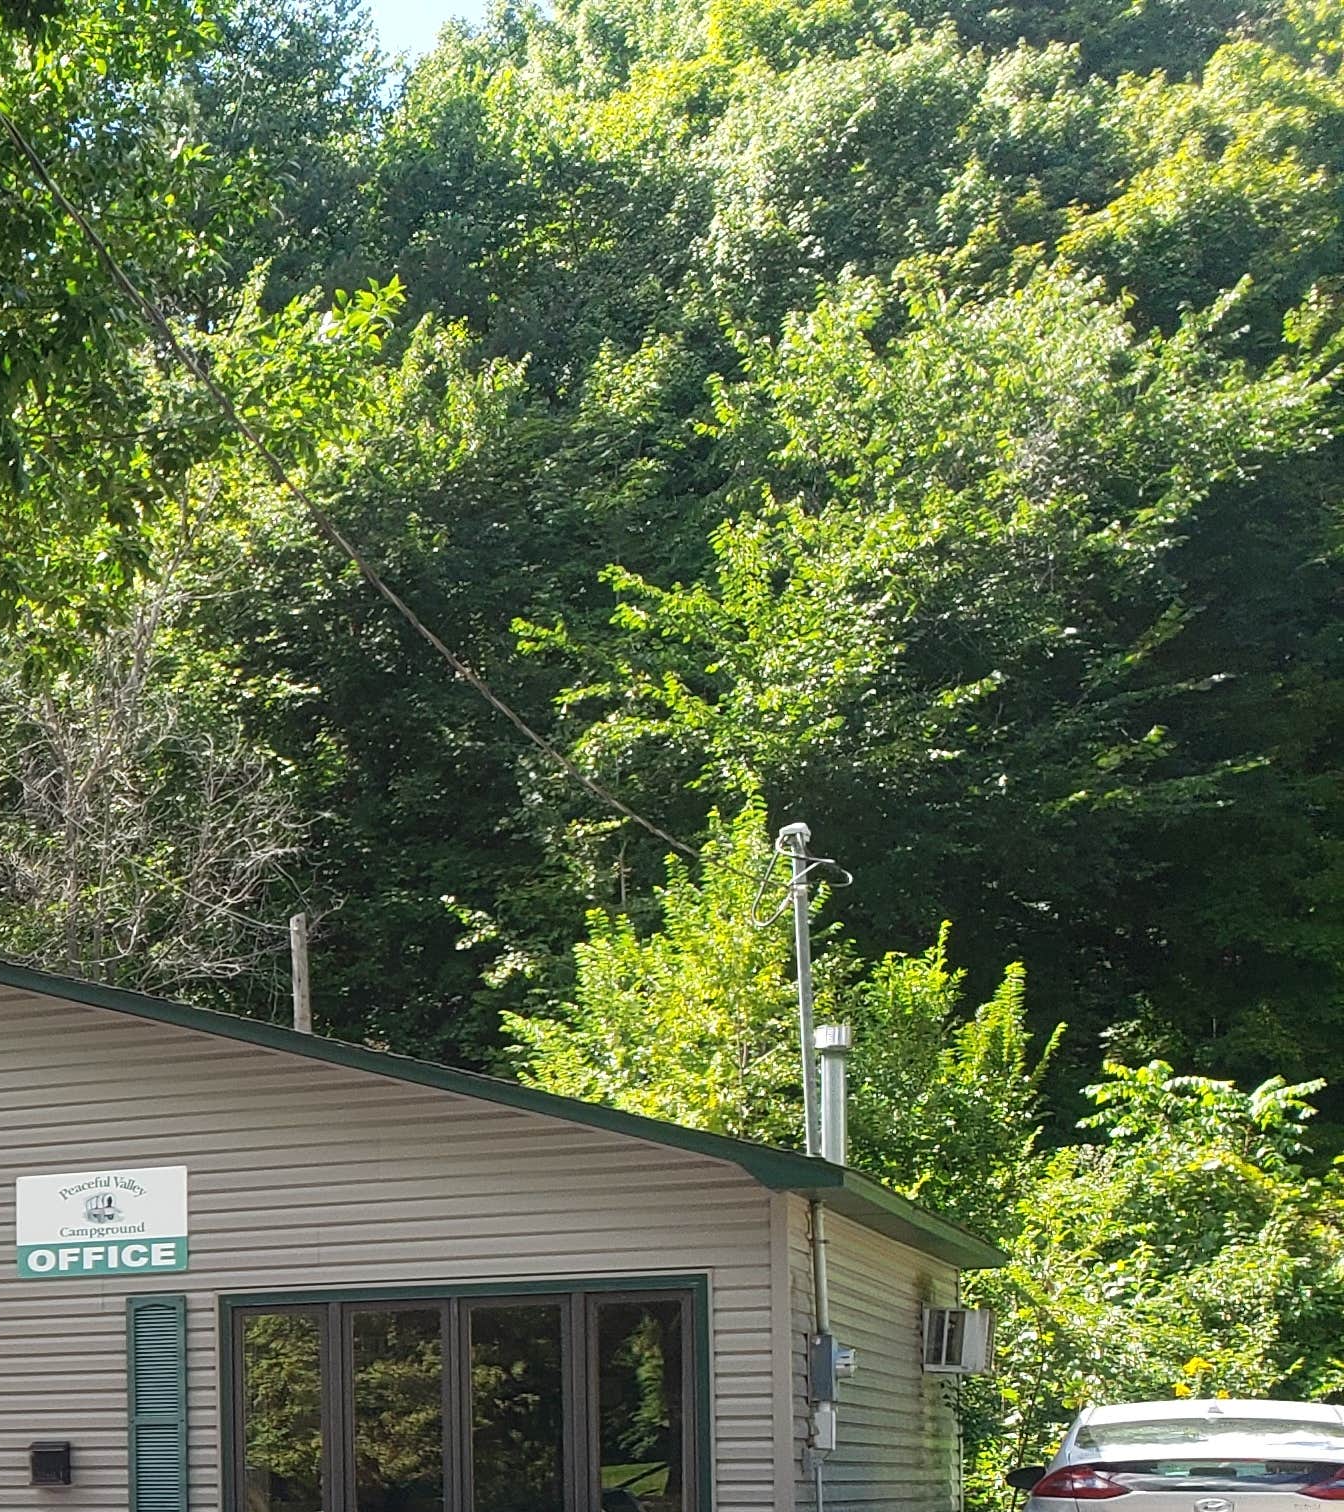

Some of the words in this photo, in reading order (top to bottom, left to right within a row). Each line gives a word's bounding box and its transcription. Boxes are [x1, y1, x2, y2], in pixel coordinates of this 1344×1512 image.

[58, 1176, 111, 1200] Peaceful
[114, 1176, 147, 1198] Valley
[60, 1222, 145, 1238] Campground
[27, 1243, 176, 1272] OFFICE
